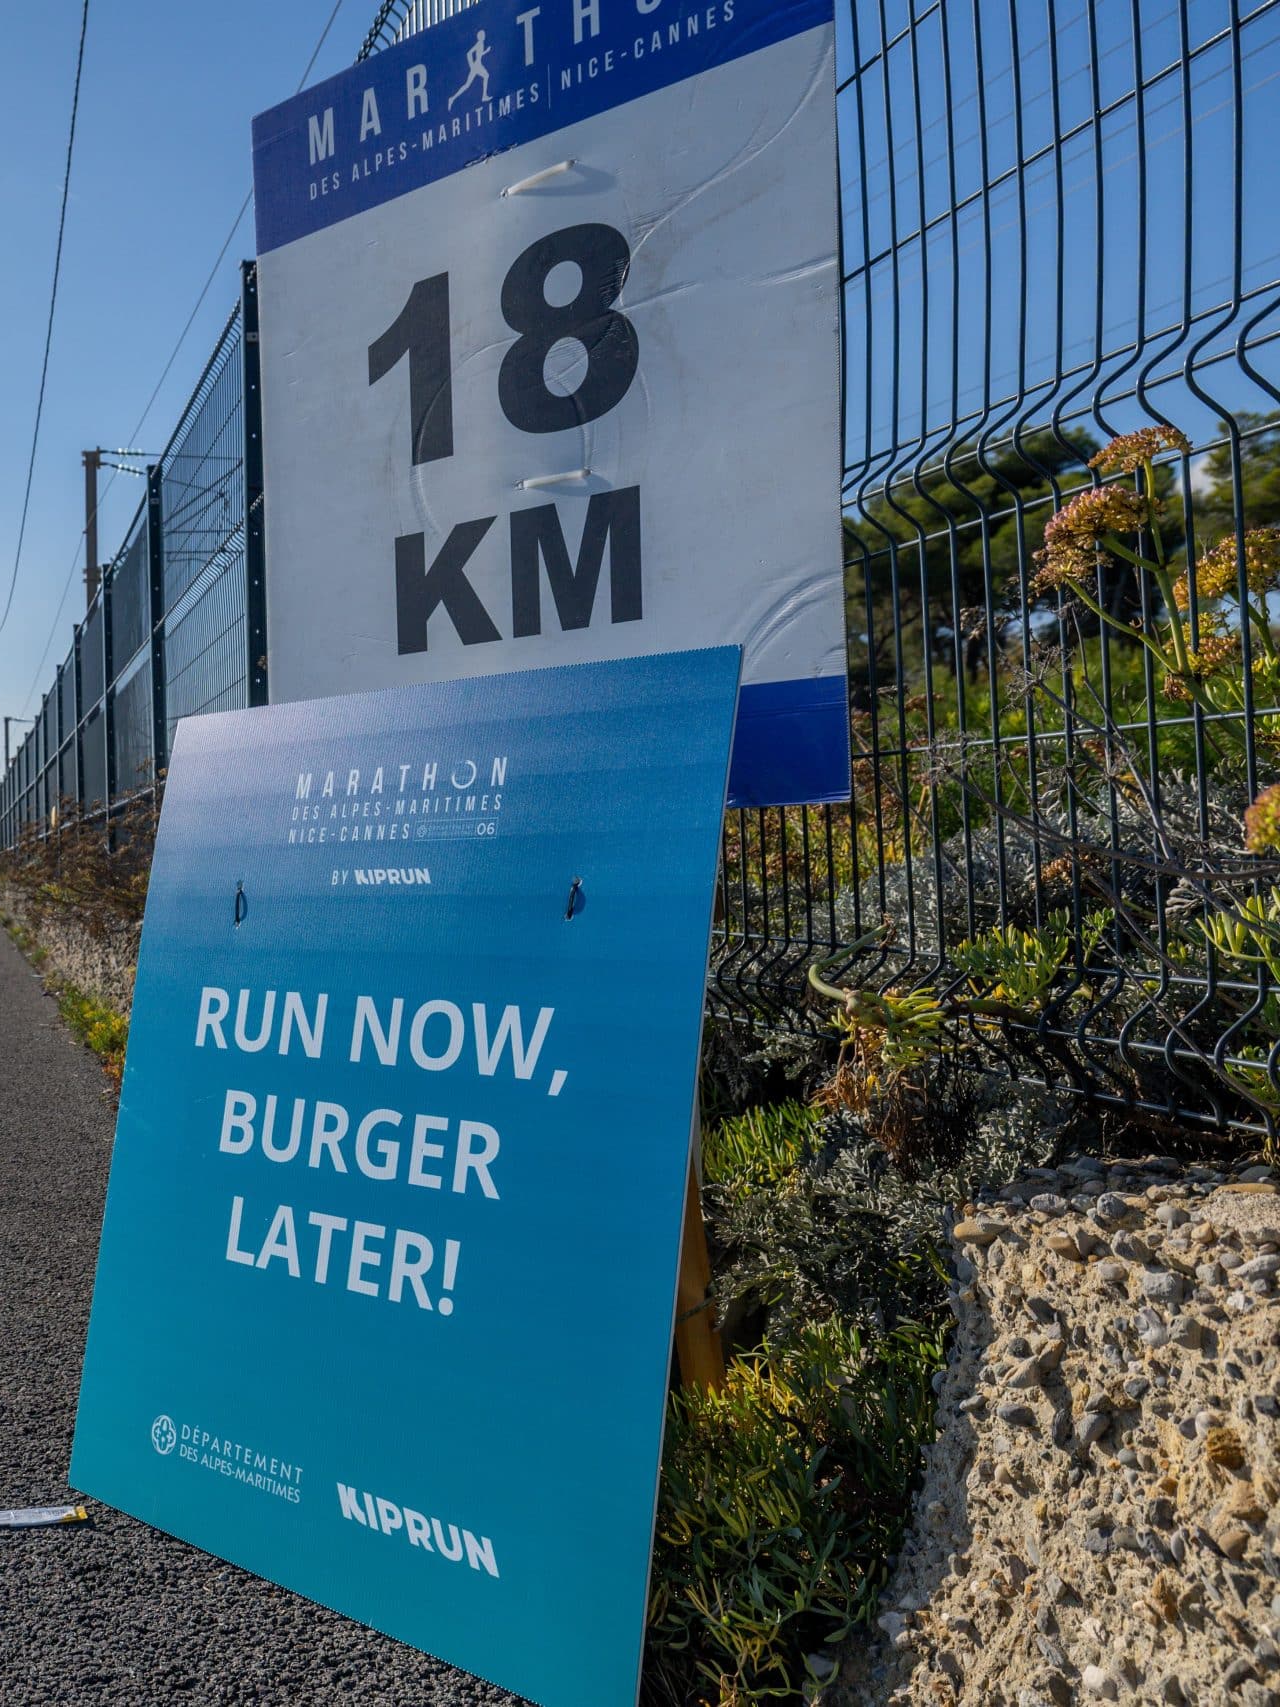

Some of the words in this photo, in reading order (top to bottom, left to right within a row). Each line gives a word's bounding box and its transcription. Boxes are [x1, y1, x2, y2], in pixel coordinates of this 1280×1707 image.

[310, 172, 340, 200] DES
[352, 83, 539, 182] ALPES-MARITIMES
[561, 0, 734, 90] NICE-CANNES
[368, 222, 639, 466] 18
[395, 485, 642, 655] KM
[292, 805, 320, 821] DES
[330, 794, 502, 819] ALPES-MARITIMES
[295, 757, 508, 800] MARATHON
[288, 823, 410, 844] NICE-CANNES
[477, 822, 495, 835] 06
[331, 870, 349, 885] BY
[354, 868, 431, 885] KIPRUN
[195, 986, 329, 1059] RUN
[349, 995, 568, 1096] NOW,
[219, 1088, 501, 1200] BURGER
[225, 1195, 461, 1316] LATER!
[180, 1444, 198, 1462] DES
[201, 1453, 301, 1503] ALPES-MARITIMES
[181, 1424, 303, 1484] DÉPARTEMENT
[336, 1482, 500, 1578] KIPRUN
